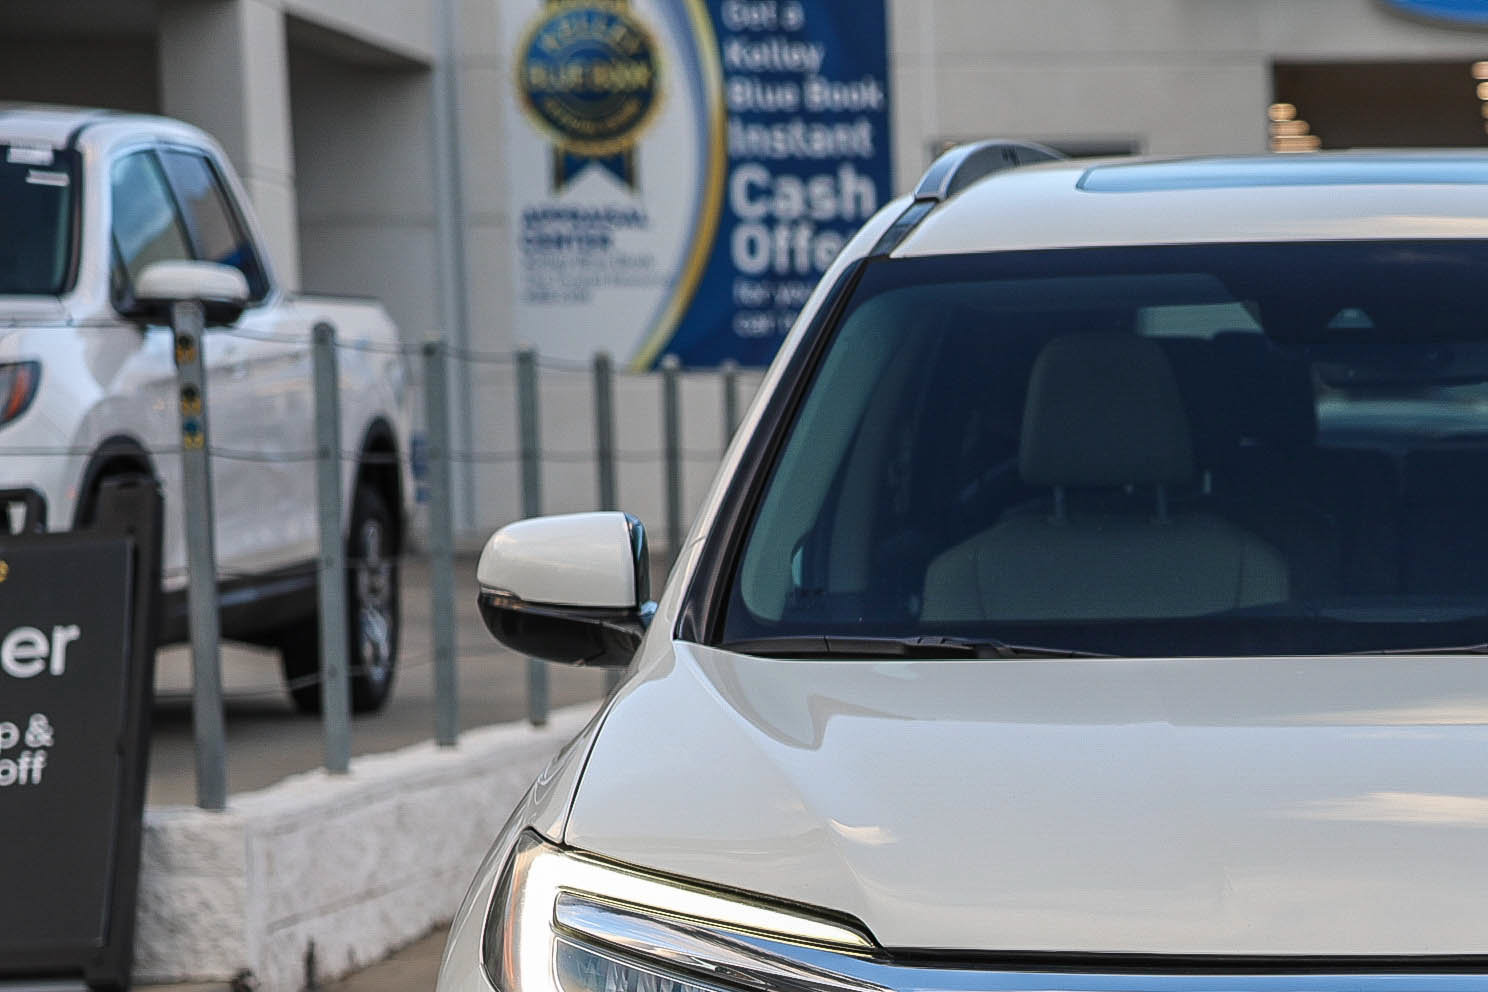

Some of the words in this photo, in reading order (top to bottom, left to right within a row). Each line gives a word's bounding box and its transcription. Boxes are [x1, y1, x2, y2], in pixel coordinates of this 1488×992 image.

[724, 38, 825, 74] Kelley
[728, 77, 799, 112] Blue
[804, 75, 883, 112] Book
[729, 118, 874, 158] Instant
[730, 163, 877, 222] Cash
